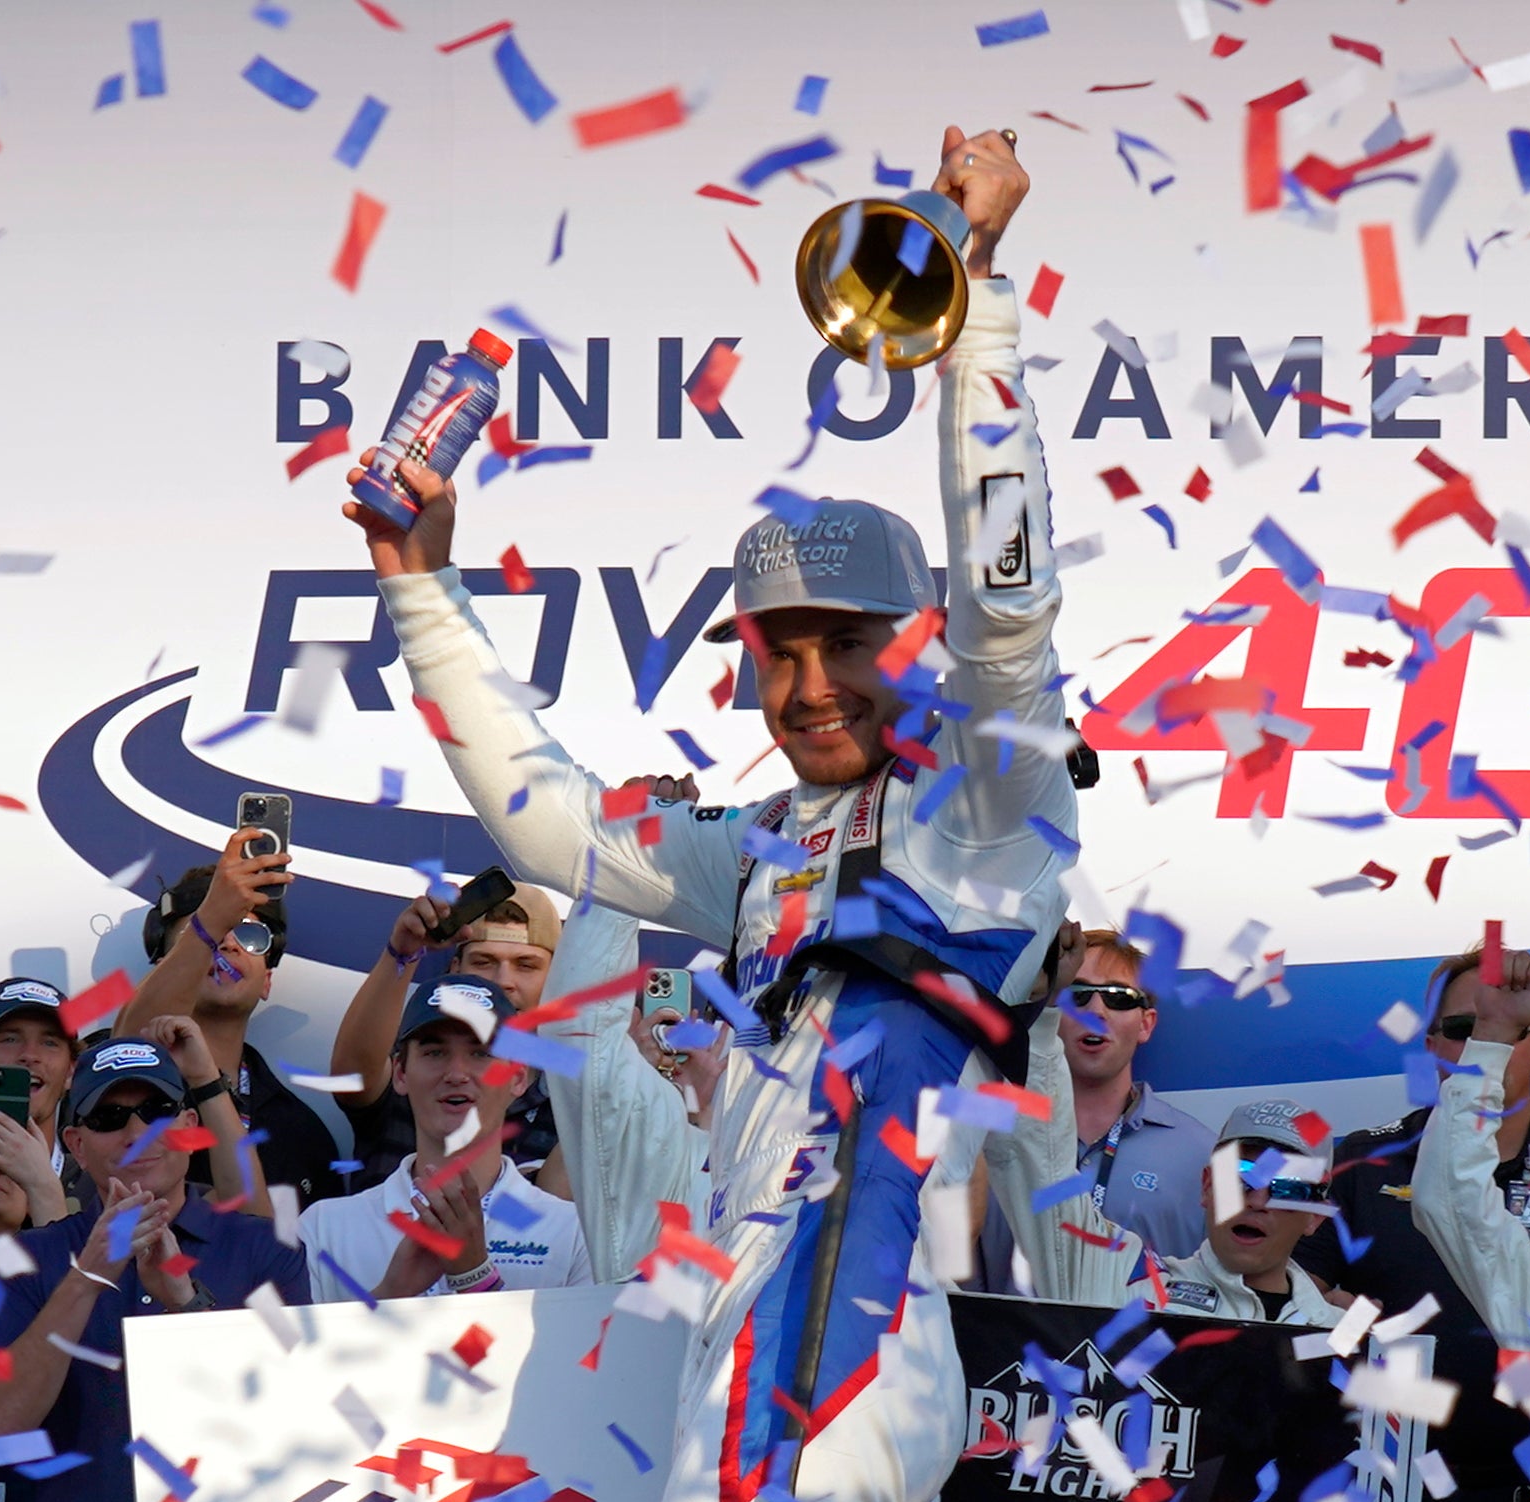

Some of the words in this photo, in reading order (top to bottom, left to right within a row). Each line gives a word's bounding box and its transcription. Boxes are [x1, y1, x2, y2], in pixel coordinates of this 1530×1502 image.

[276, 336, 745, 442] BANK
[245, 567, 951, 713] ROV
[967, 1388, 1202, 1479] BUSCH
[1008, 1462, 1135, 1501] LIGH
